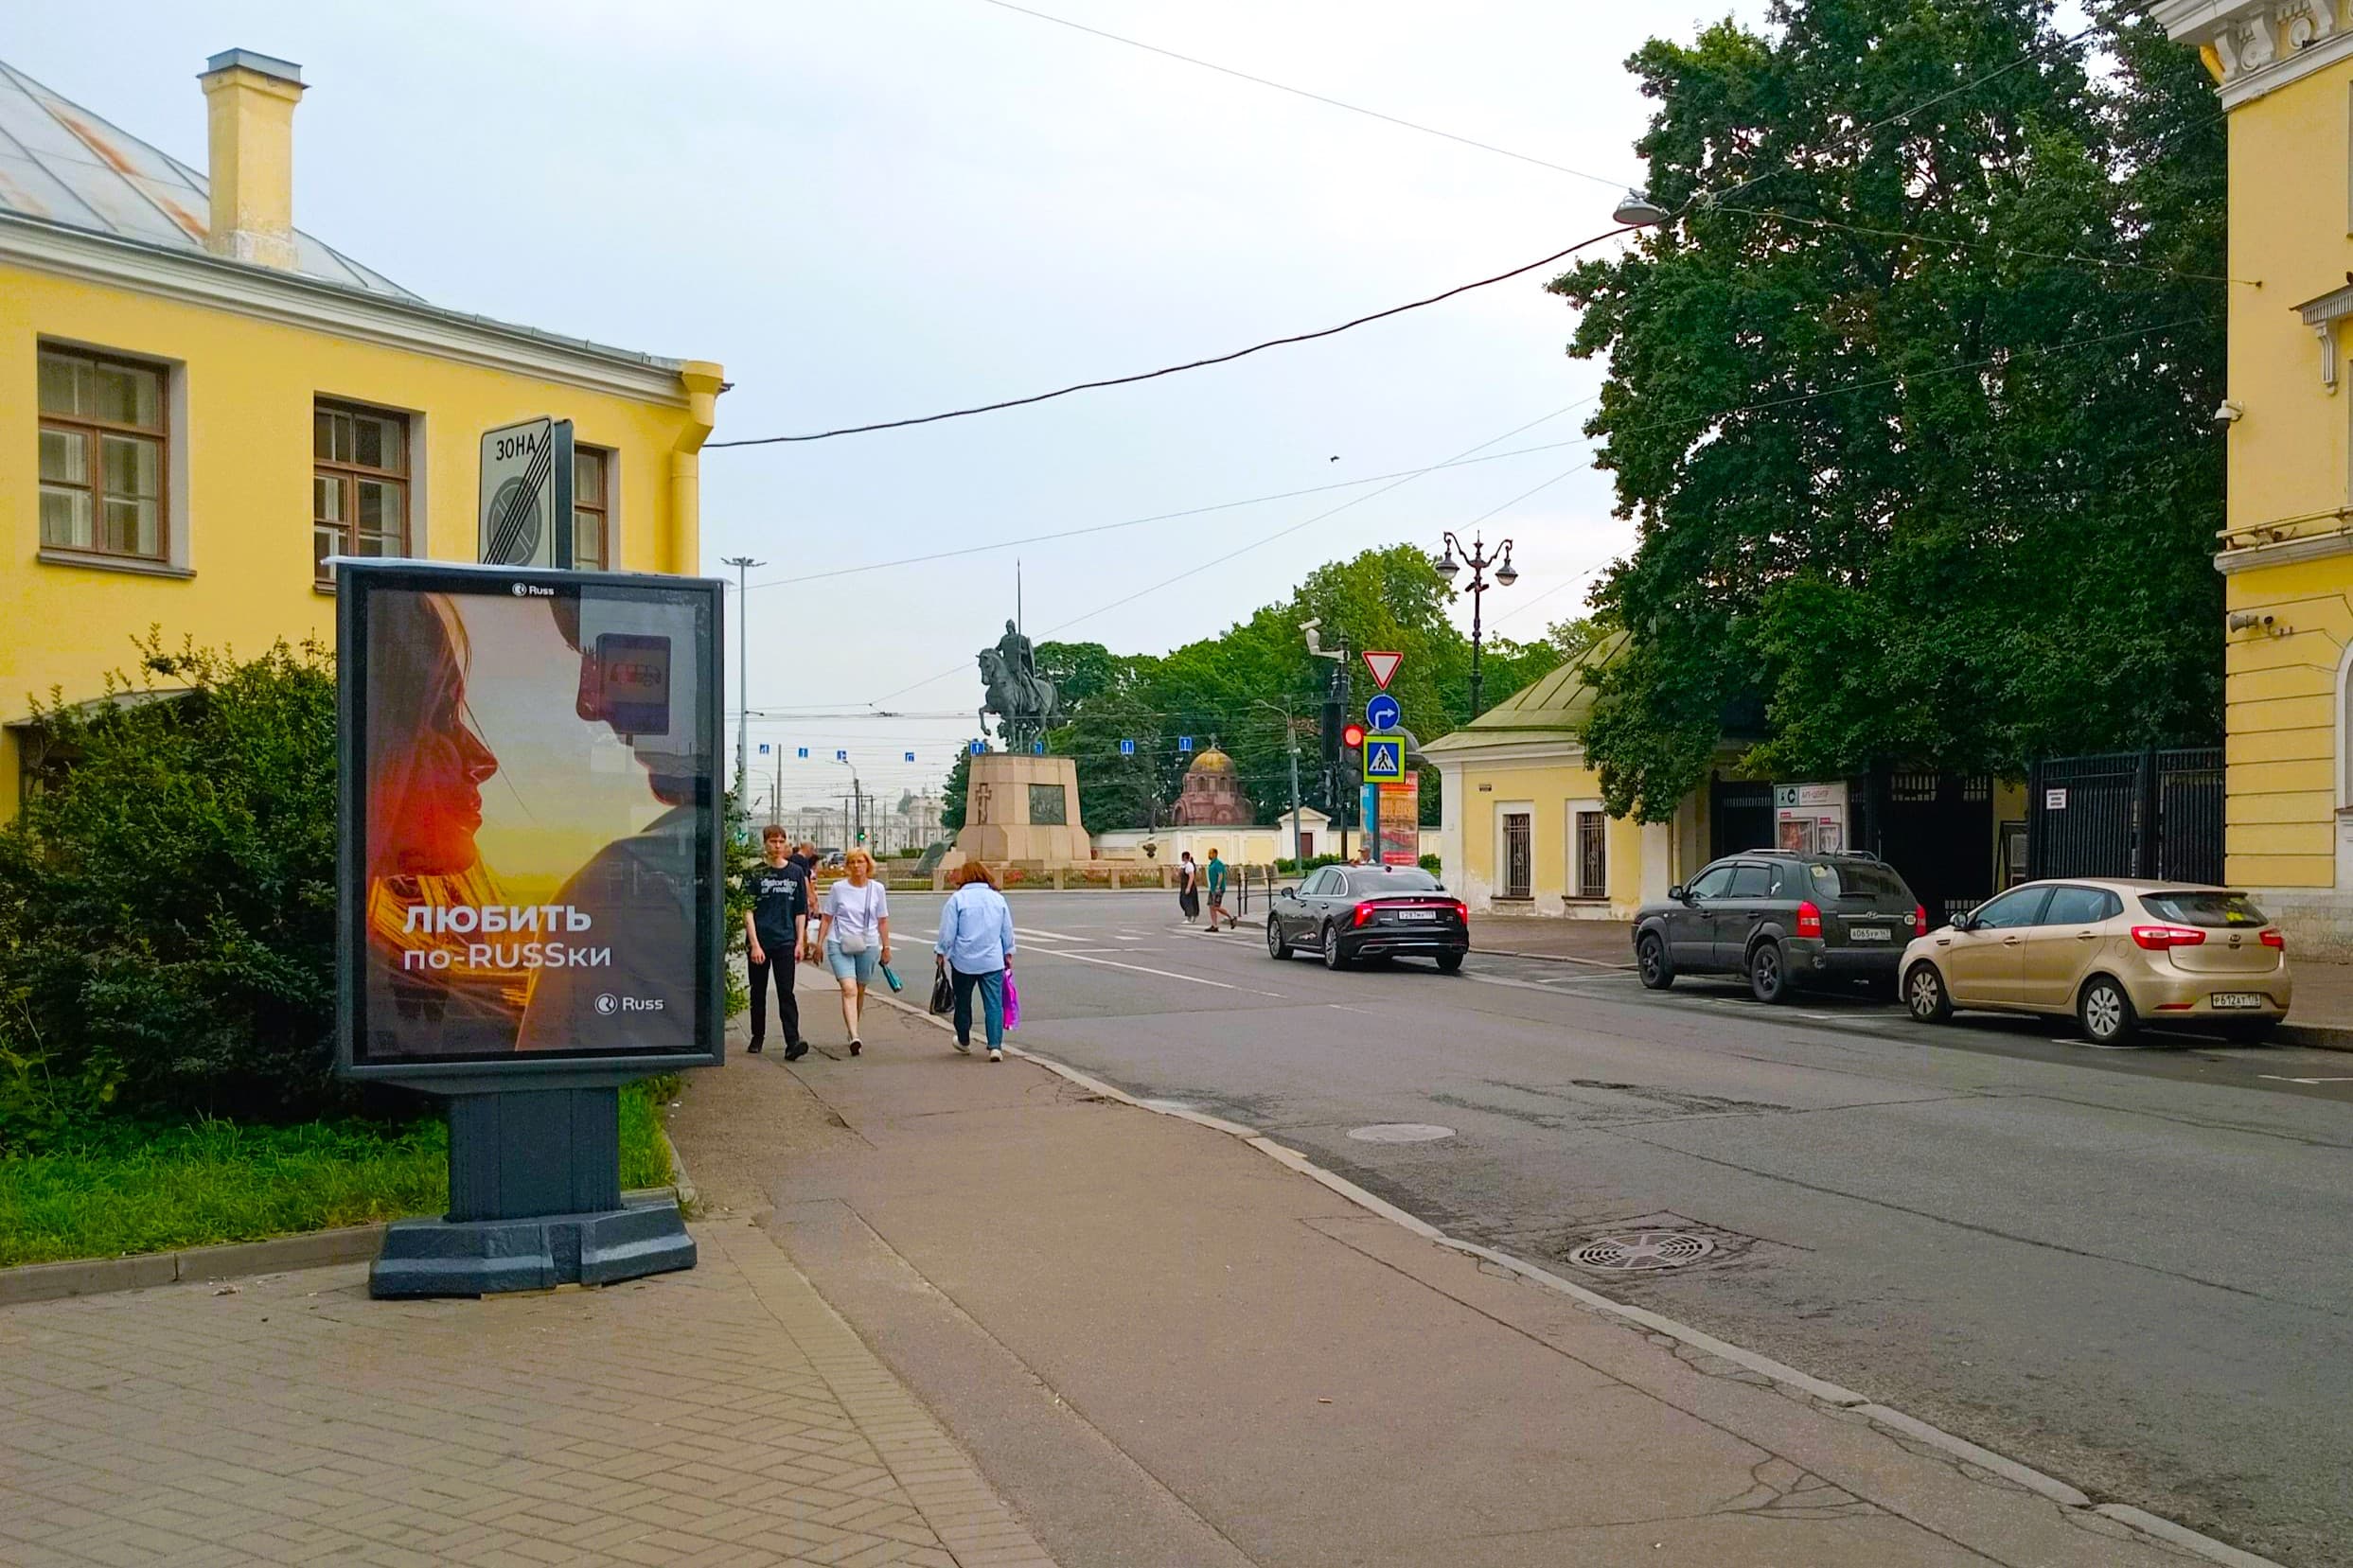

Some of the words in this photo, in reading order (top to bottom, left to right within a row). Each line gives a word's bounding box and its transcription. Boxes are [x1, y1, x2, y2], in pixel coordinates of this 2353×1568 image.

[496, 432, 537, 461] ЗОНА
[529, 585, 555, 596] Russ
[760, 877, 798, 889] distortion
[772, 886, 796, 896] reality
[402, 905, 592, 934] ЛЮБИТЬ
[403, 943, 611, 971] по-RUSSки
[622, 996, 664, 1012] Russ
